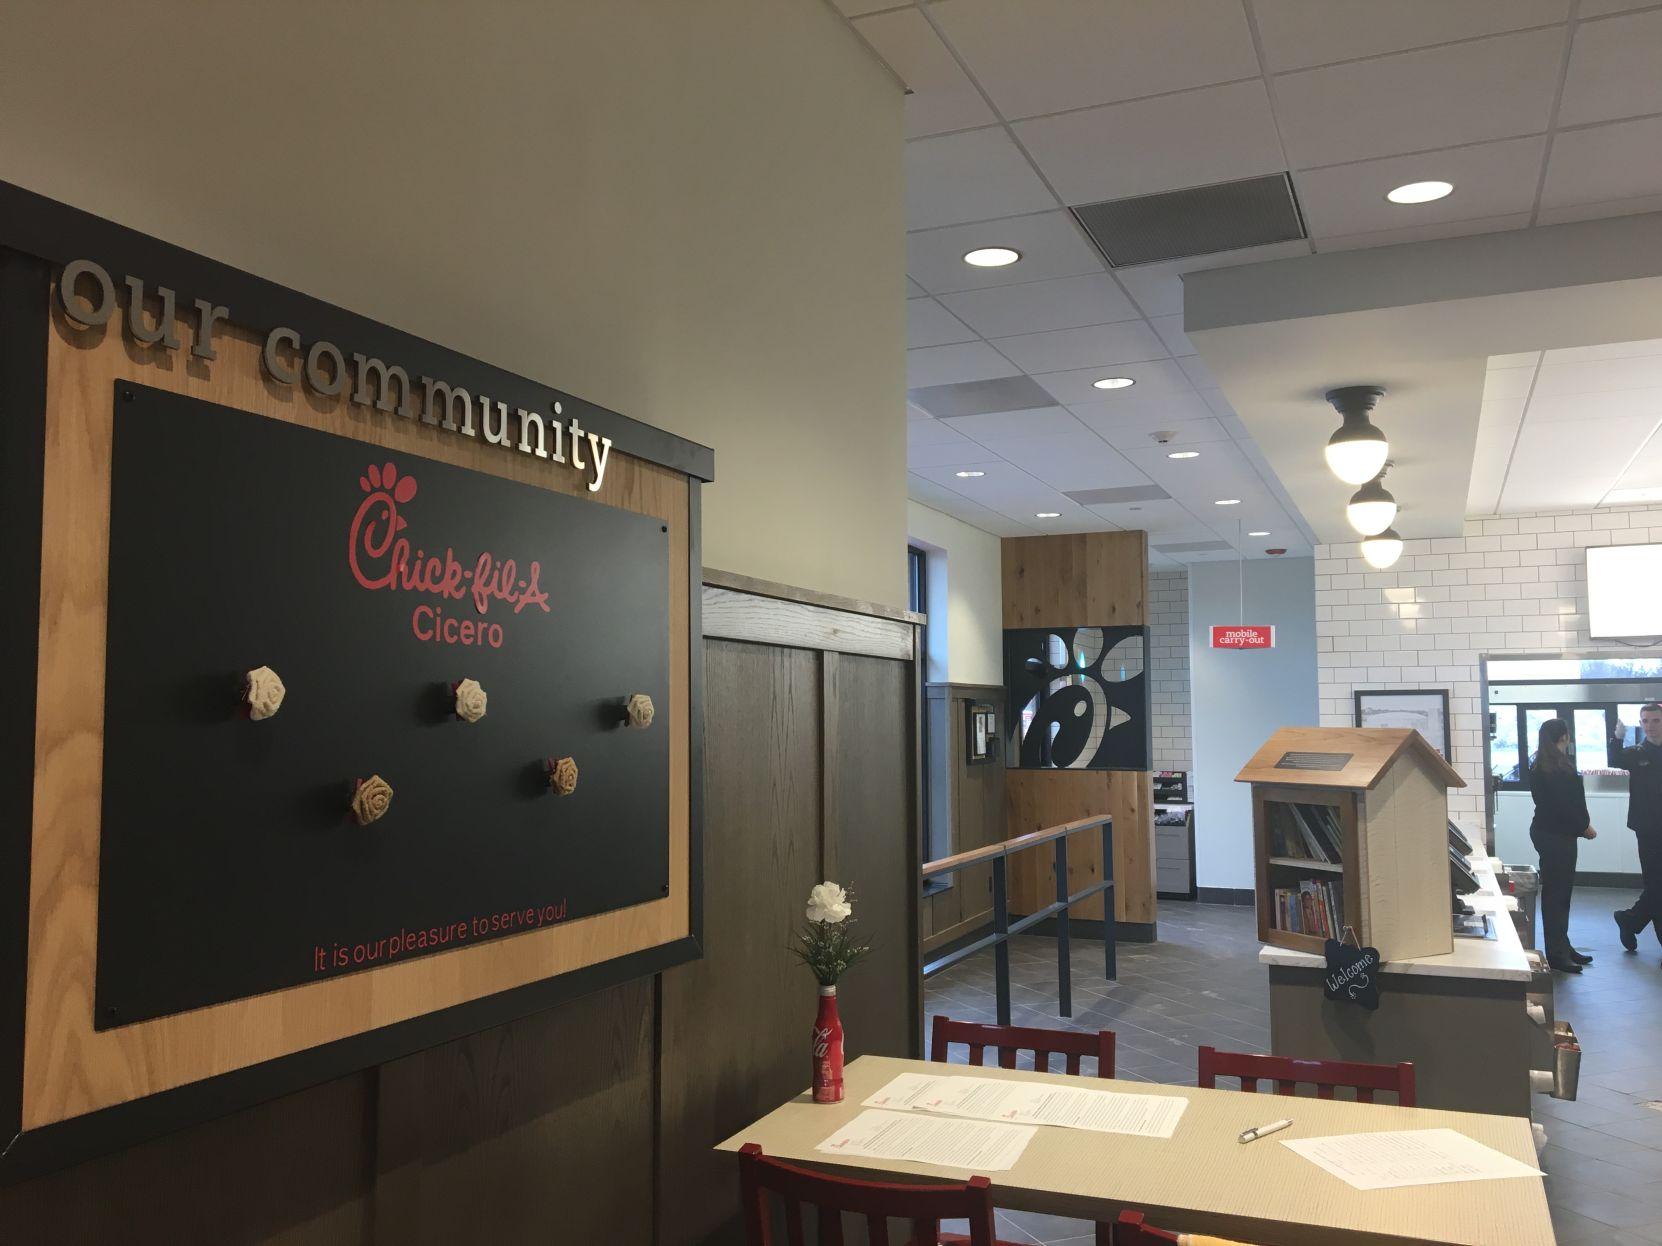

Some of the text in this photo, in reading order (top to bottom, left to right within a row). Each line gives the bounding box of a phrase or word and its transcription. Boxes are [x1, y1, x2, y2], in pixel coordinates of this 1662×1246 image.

[59, 258, 612, 492] our community
[349, 490, 550, 614] Chick-fil-A
[412, 604, 504, 648] Cicero
[1219, 637, 1265, 646] carry-out
[1225, 629, 1258, 638] mobile
[313, 898, 567, 972] It is our pleasure to serve you!
[1325, 954, 1374, 992] Welcome
